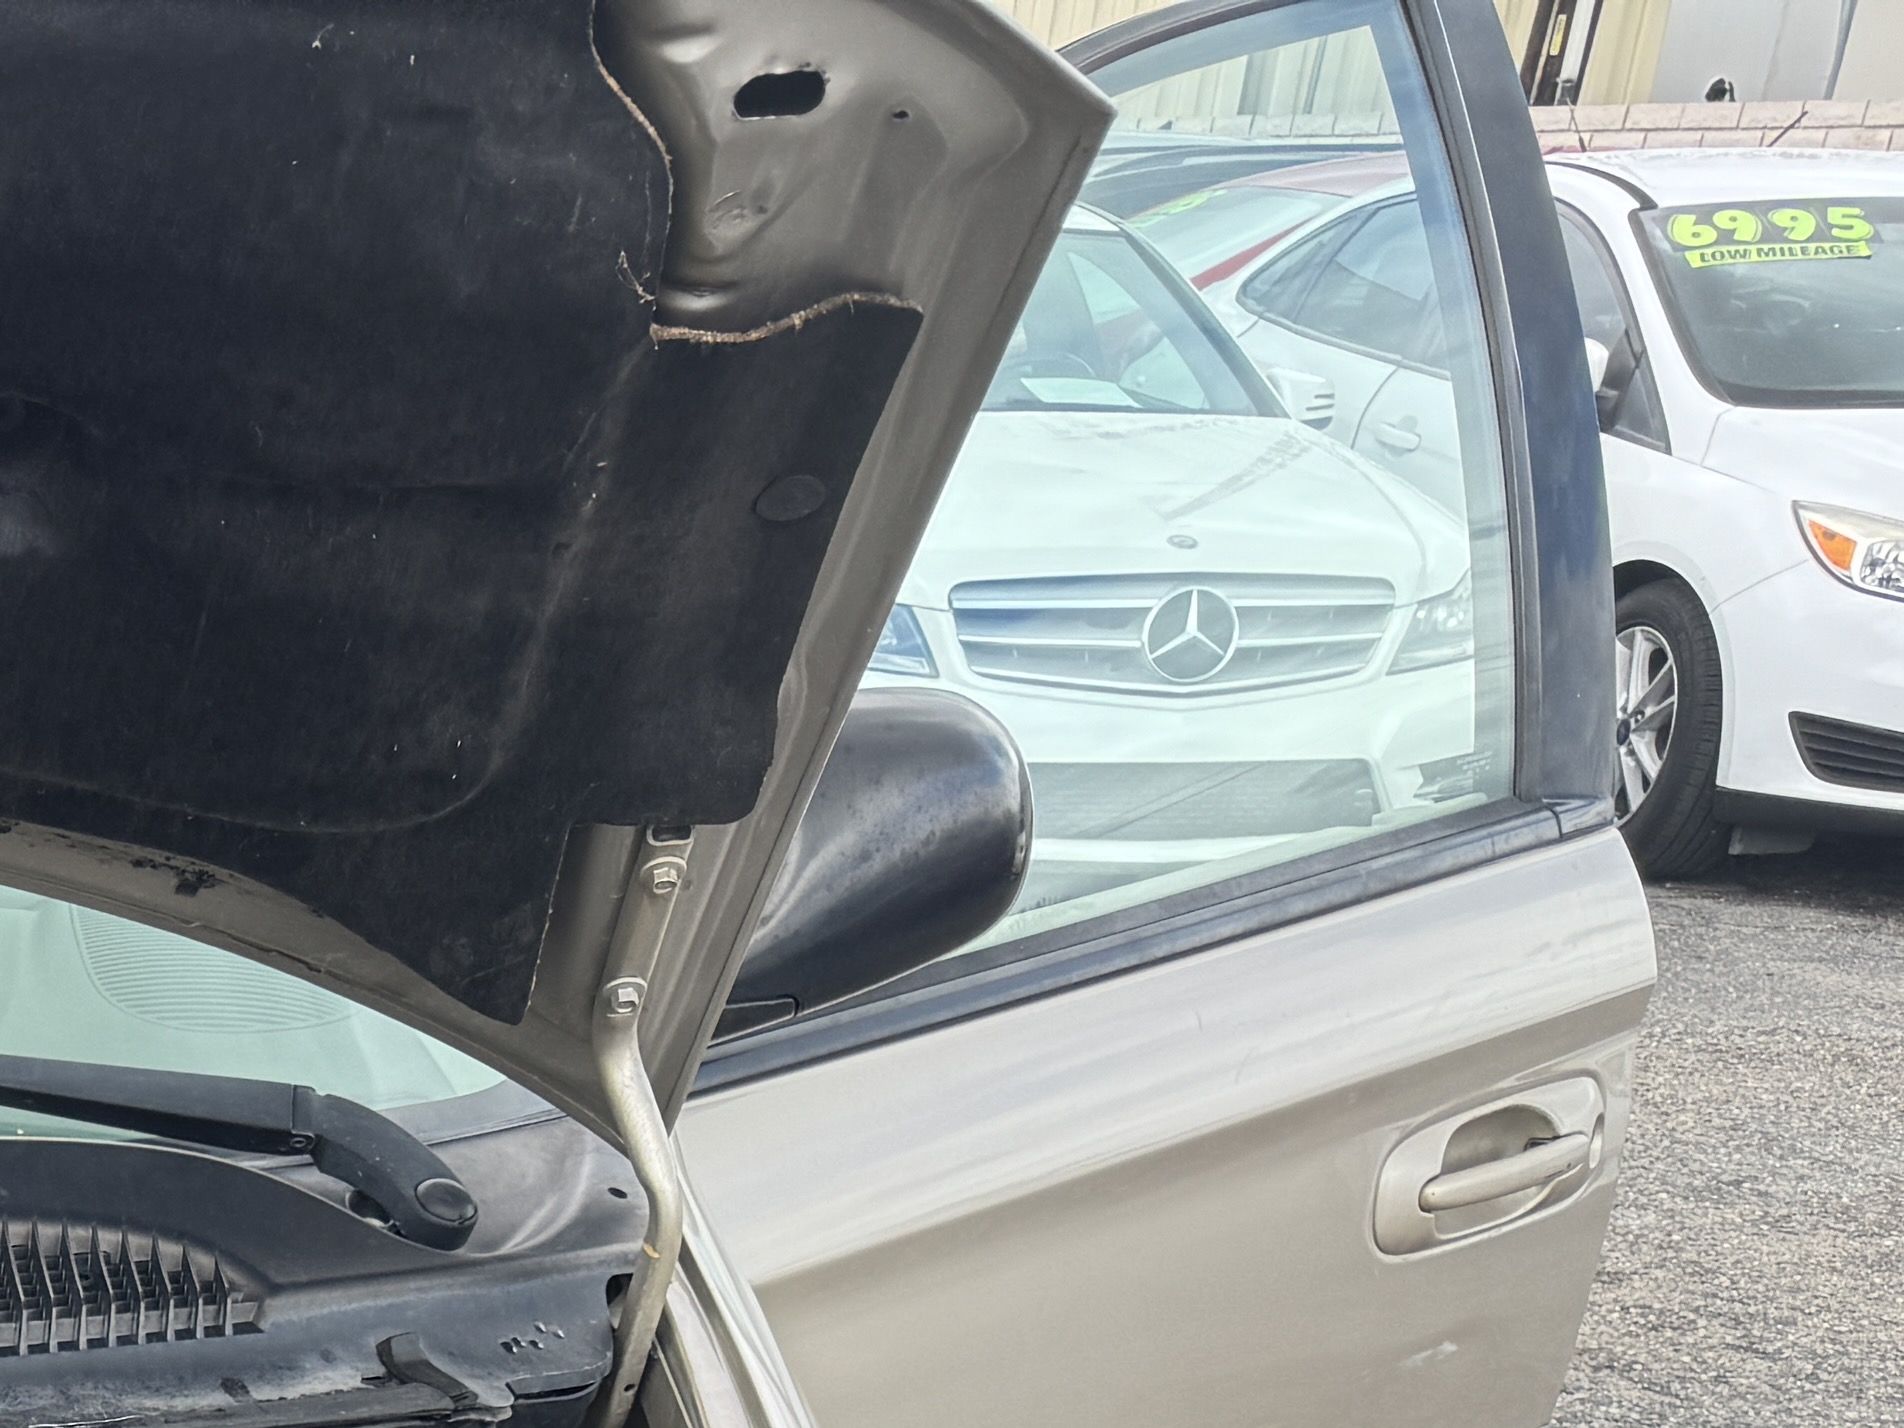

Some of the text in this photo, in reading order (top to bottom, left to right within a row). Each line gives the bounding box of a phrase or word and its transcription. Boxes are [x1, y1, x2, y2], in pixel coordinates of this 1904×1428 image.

[1667, 206, 1874, 247] 6995
[1699, 244, 1860, 263] LOW MILEAGE
